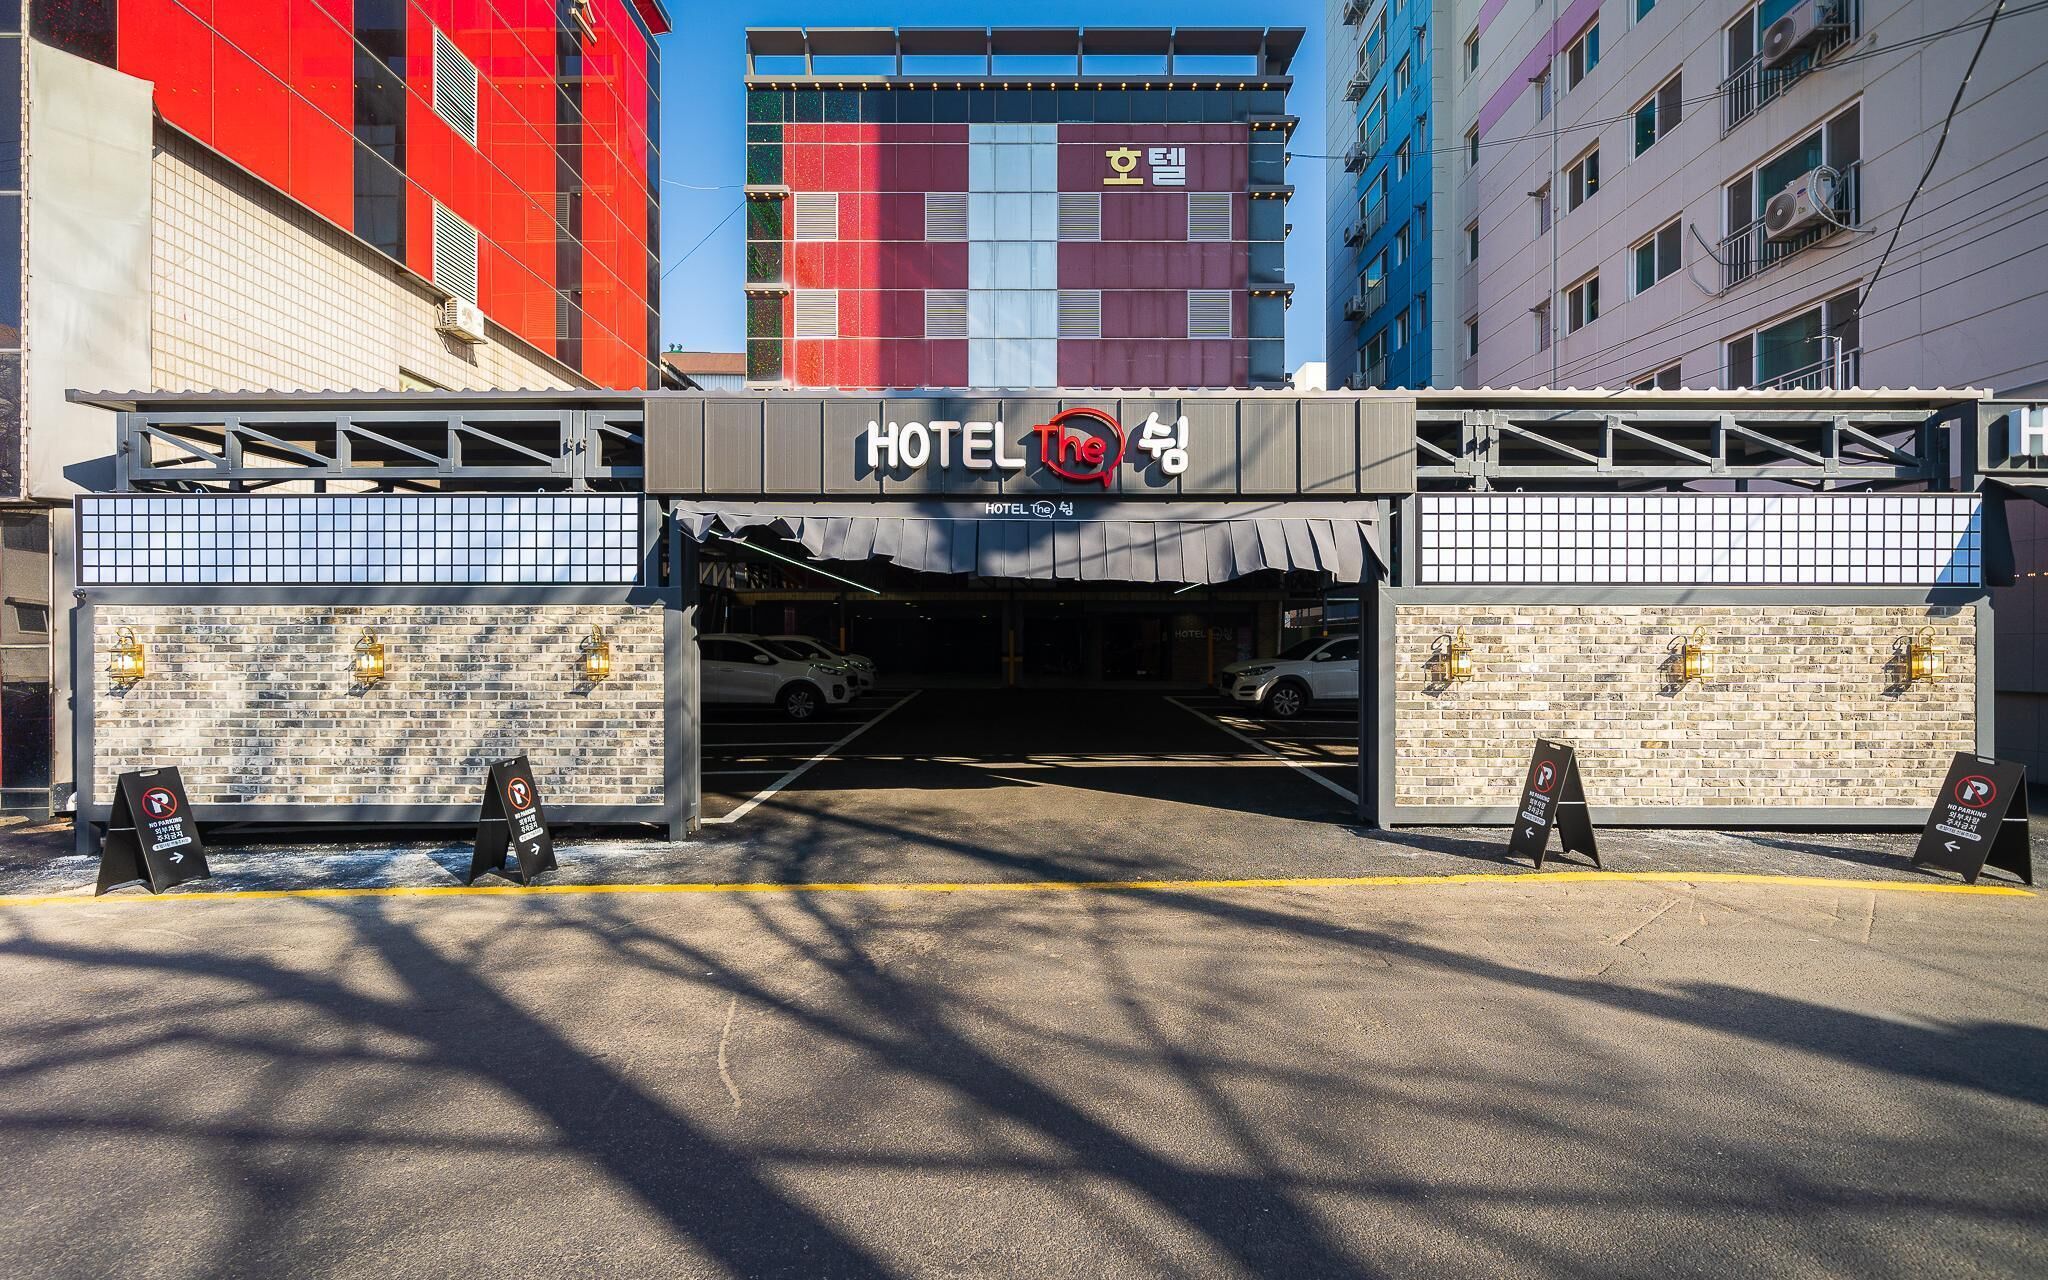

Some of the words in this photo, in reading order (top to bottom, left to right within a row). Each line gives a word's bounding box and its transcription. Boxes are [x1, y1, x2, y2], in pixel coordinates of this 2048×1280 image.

[1103, 146, 1186, 186] 호텔
[867, 420, 1026, 470] HOTEL
[1032, 422, 1107, 465] The
[985, 503, 1029, 514] HOTEL
[1030, 503, 1051, 514] The
[1957, 806, 1987, 818] PARKING
[158, 816, 183, 826] PARKING
[1946, 818, 1977, 832] 주차금지
[157, 831, 183, 842] 주차금지
